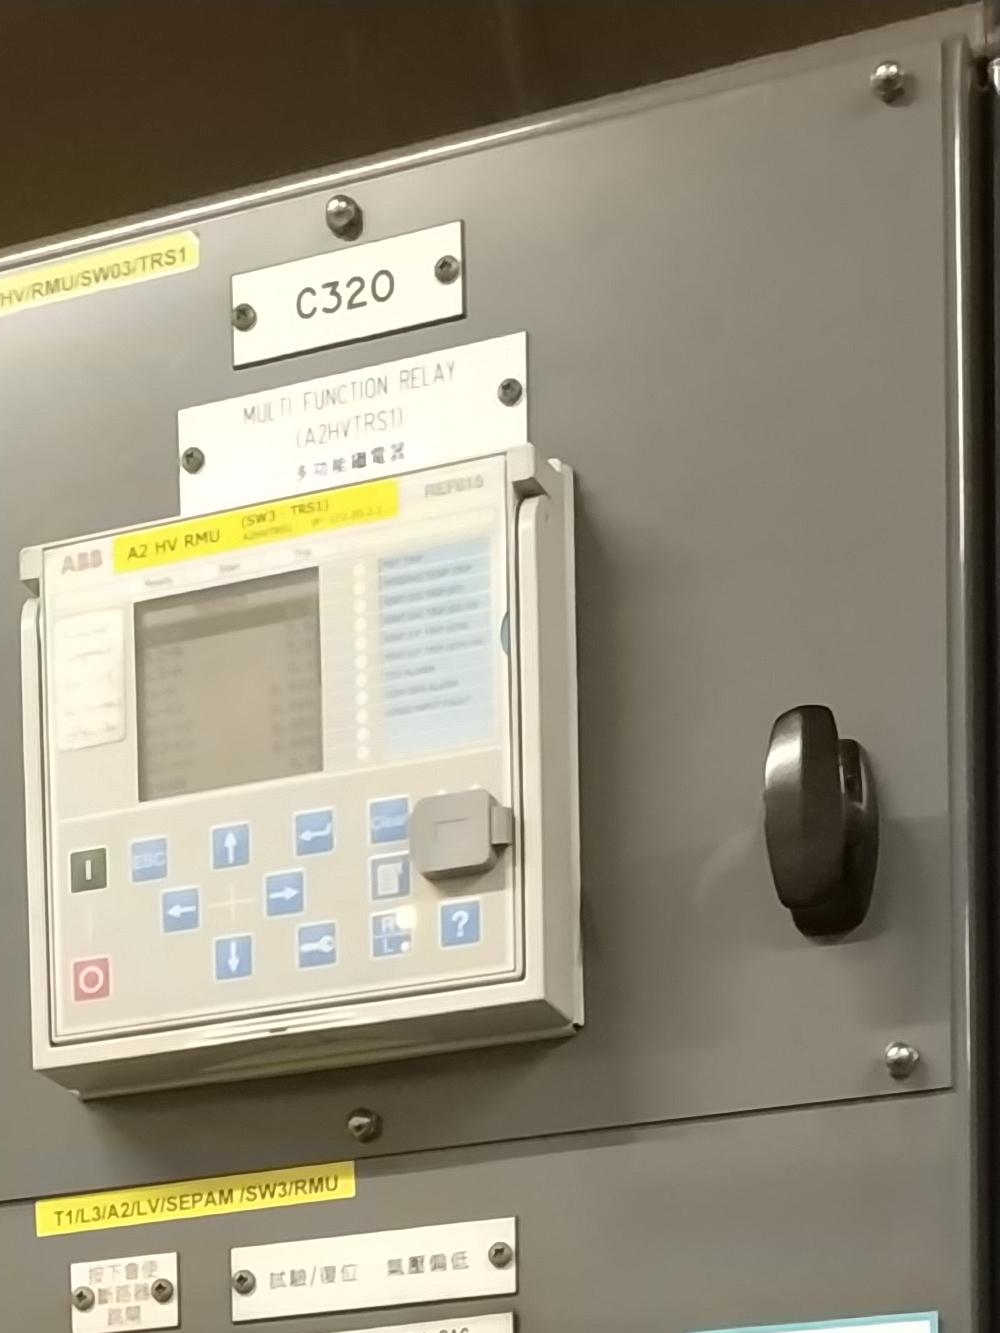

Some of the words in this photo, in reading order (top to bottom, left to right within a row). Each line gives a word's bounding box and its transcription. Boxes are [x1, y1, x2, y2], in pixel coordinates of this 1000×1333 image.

[296, 269, 395, 320] C320
[303, 376, 389, 411] FUNCTION
[400, 360, 456, 391] RELAY
[60, 549, 104, 574] ABB
[127, 543, 148, 561] A2
[154, 536, 178, 554] HV
[184, 528, 221, 548] RMU
[53, 1188, 235, 1227] T1/L3/A2/LV/SEPAM
[239, 1175, 339, 1204] /SW3/RMU
